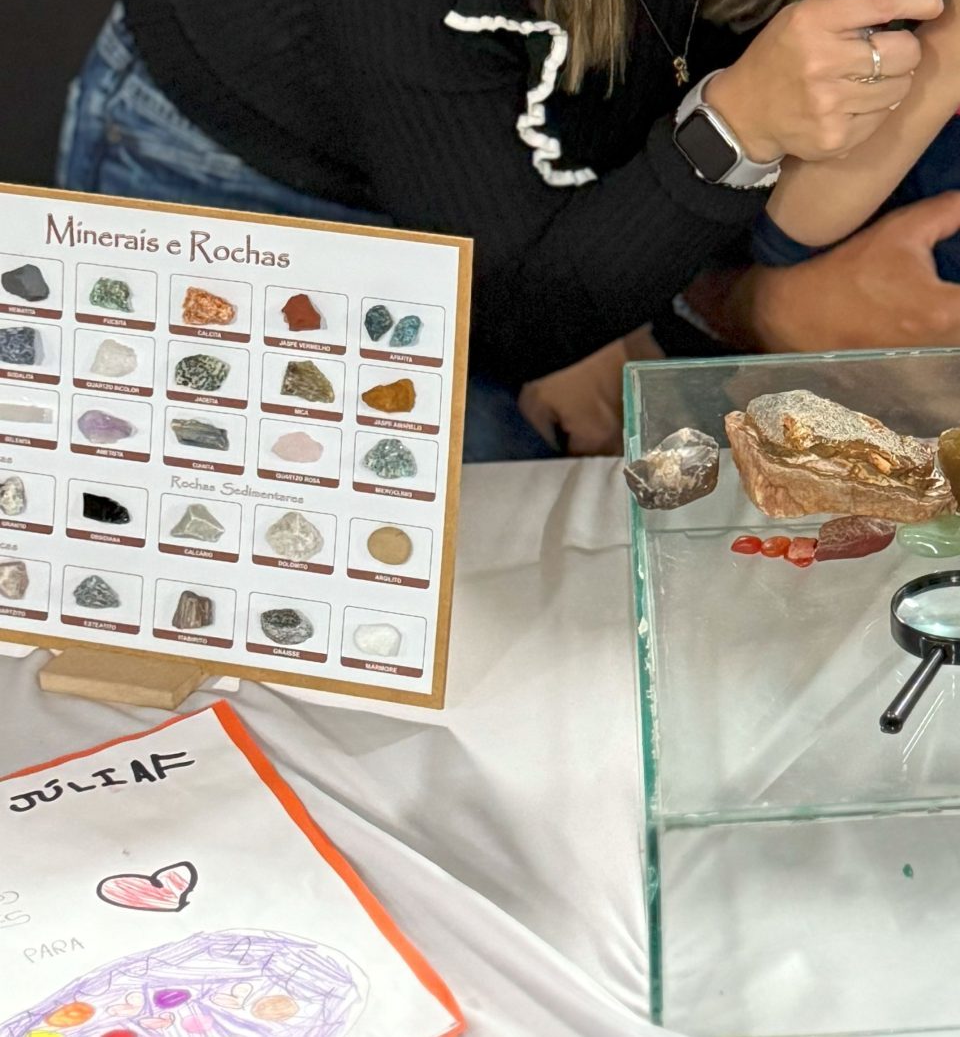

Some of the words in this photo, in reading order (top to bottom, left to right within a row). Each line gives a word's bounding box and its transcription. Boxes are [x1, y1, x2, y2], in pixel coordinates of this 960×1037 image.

[45, 212, 160, 254] Minerais
[166, 239, 182, 256] e
[189, 230, 291, 269] Rochas
[197, 329, 222, 338] CALCITA
[279, 339, 298, 349] JASPE
[299, 342, 331, 352] VERMELHO
[86, 381, 113, 391] QUARTZO
[373, 419, 393, 428] JASPE
[393, 421, 422, 432] AMARELO
[275, 472, 304, 481] QUARTZO
[170, 474, 217, 493] Rochas
[219, 482, 304, 504] Sedimentares
[277, 560, 309, 571] DOLOMITO
[374, 574, 402, 584] ARGILITO
[272, 648, 301, 658] GNAISSE
[23, 936, 85, 964] PARA
